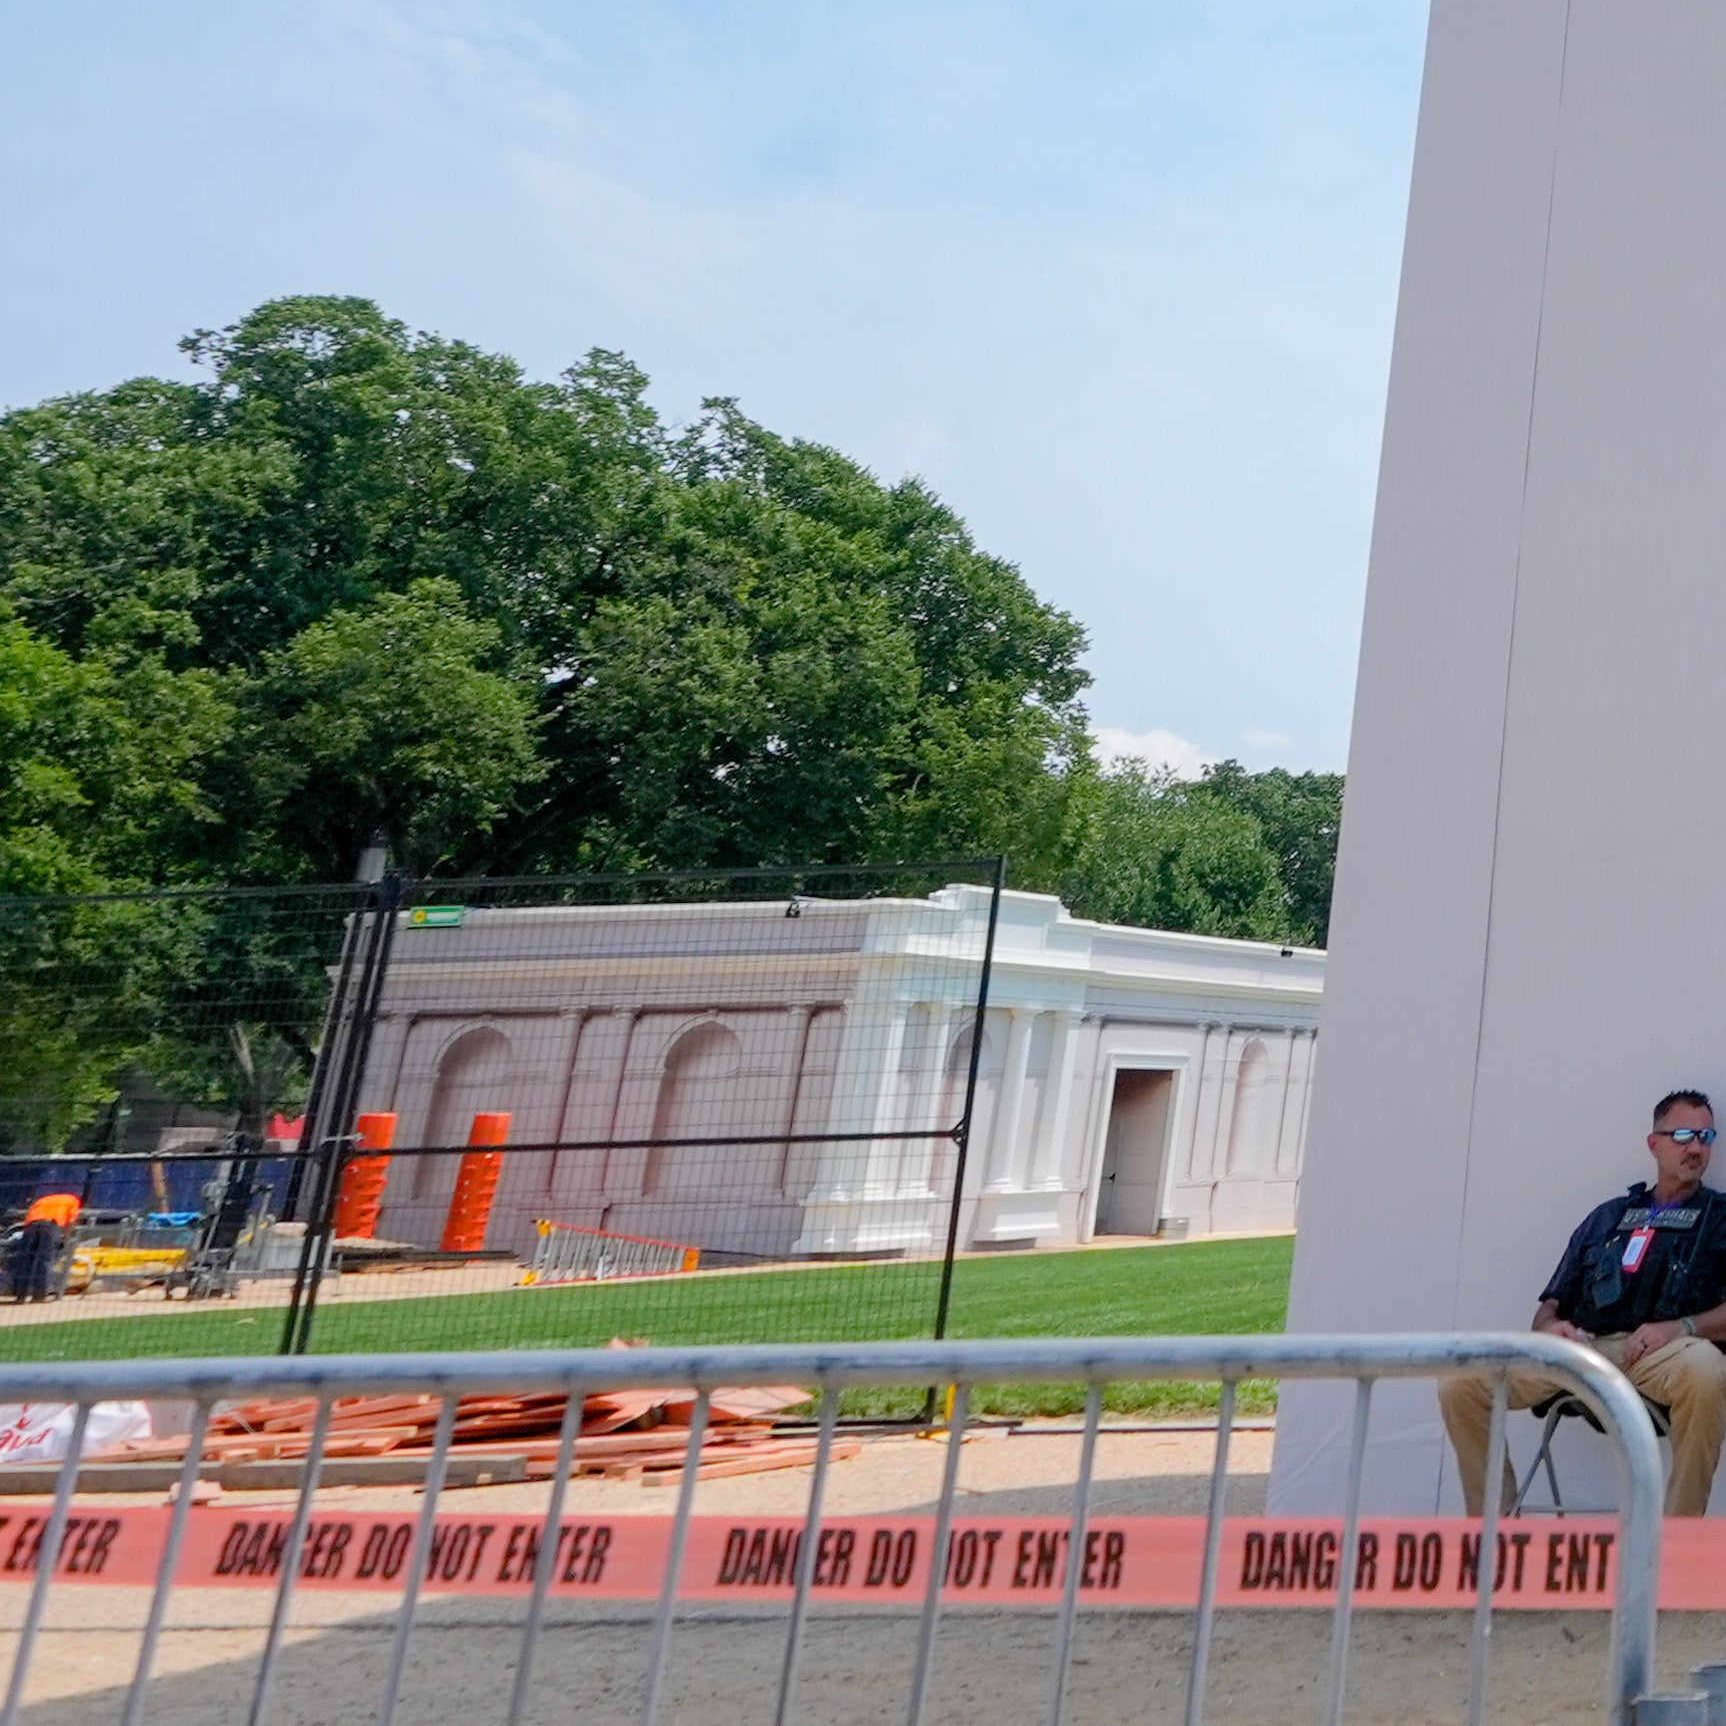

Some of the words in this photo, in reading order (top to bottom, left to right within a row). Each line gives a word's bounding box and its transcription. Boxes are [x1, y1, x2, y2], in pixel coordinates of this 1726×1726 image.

[355, 1523, 412, 1580] DO
[425, 1523, 495, 1582] NOT
[496, 1525, 612, 1585] ENTER
[863, 1529, 917, 1588] DO
[1240, 1531, 1379, 1592] DANGR
[1392, 1532, 1443, 1592] DO
[1546, 1533, 1615, 1593] ENT
